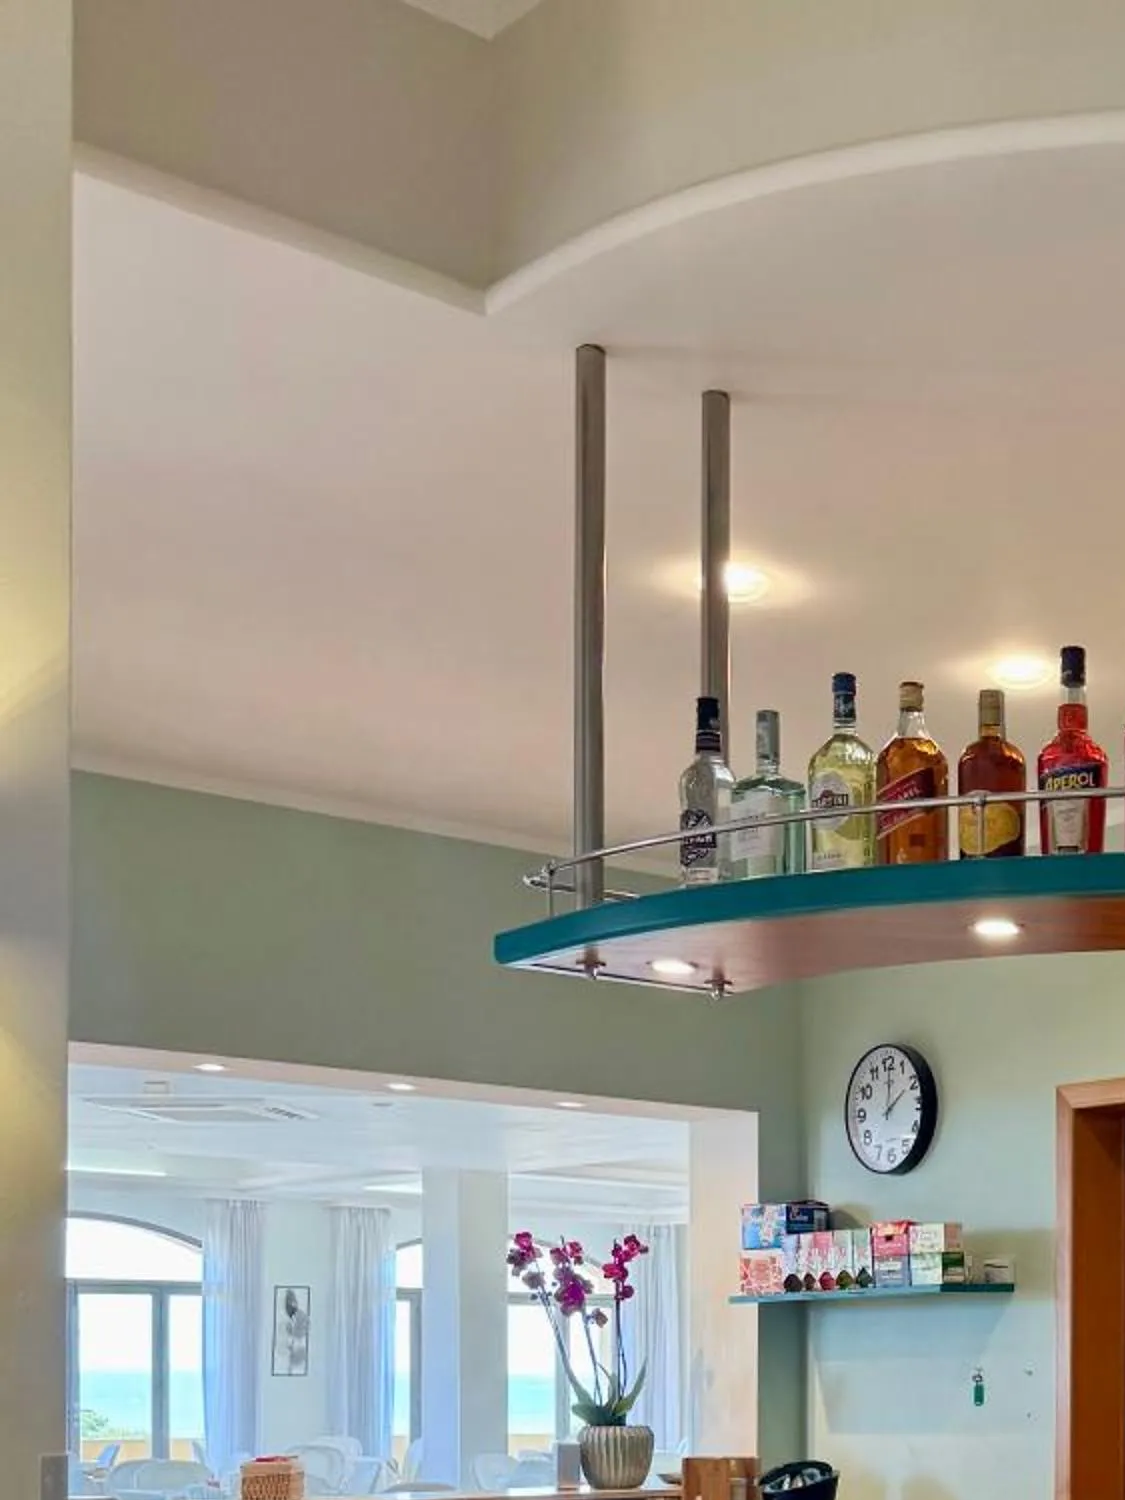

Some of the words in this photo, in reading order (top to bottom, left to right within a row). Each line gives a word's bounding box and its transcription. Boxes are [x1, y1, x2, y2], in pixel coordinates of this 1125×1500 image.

[1045, 771, 1096, 792] APEROL
[882, 1056, 895, 1072] 12
[870, 1066, 879, 1081] 11
[909, 1074, 919, 1090] 2
[862, 1083, 873, 1100] 10
[857, 1108, 867, 1123] 9
[863, 1129, 872, 1146] 8
[873, 1144, 883, 1161] 7
[901, 1139, 910, 1155] 5
[887, 1148, 897, 1163] 6
